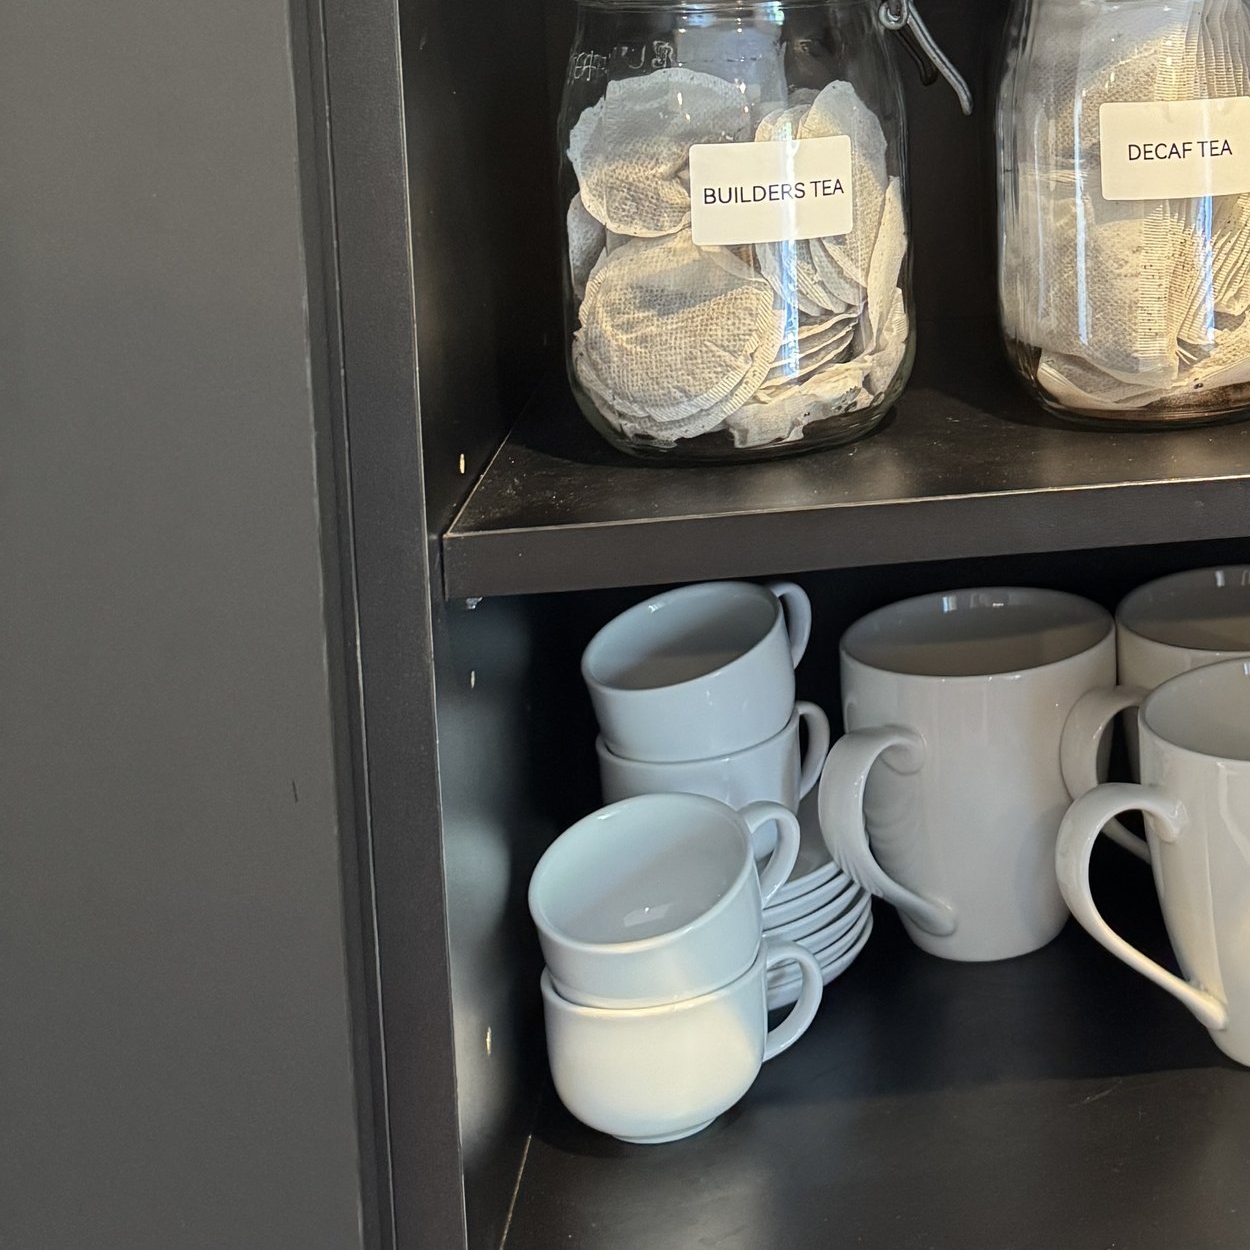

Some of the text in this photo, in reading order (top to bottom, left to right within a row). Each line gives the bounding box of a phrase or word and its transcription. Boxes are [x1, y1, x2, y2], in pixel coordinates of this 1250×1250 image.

[1128, 139, 1233, 161] DECAF TEA
[703, 178, 844, 205] BUILDERS TEA
